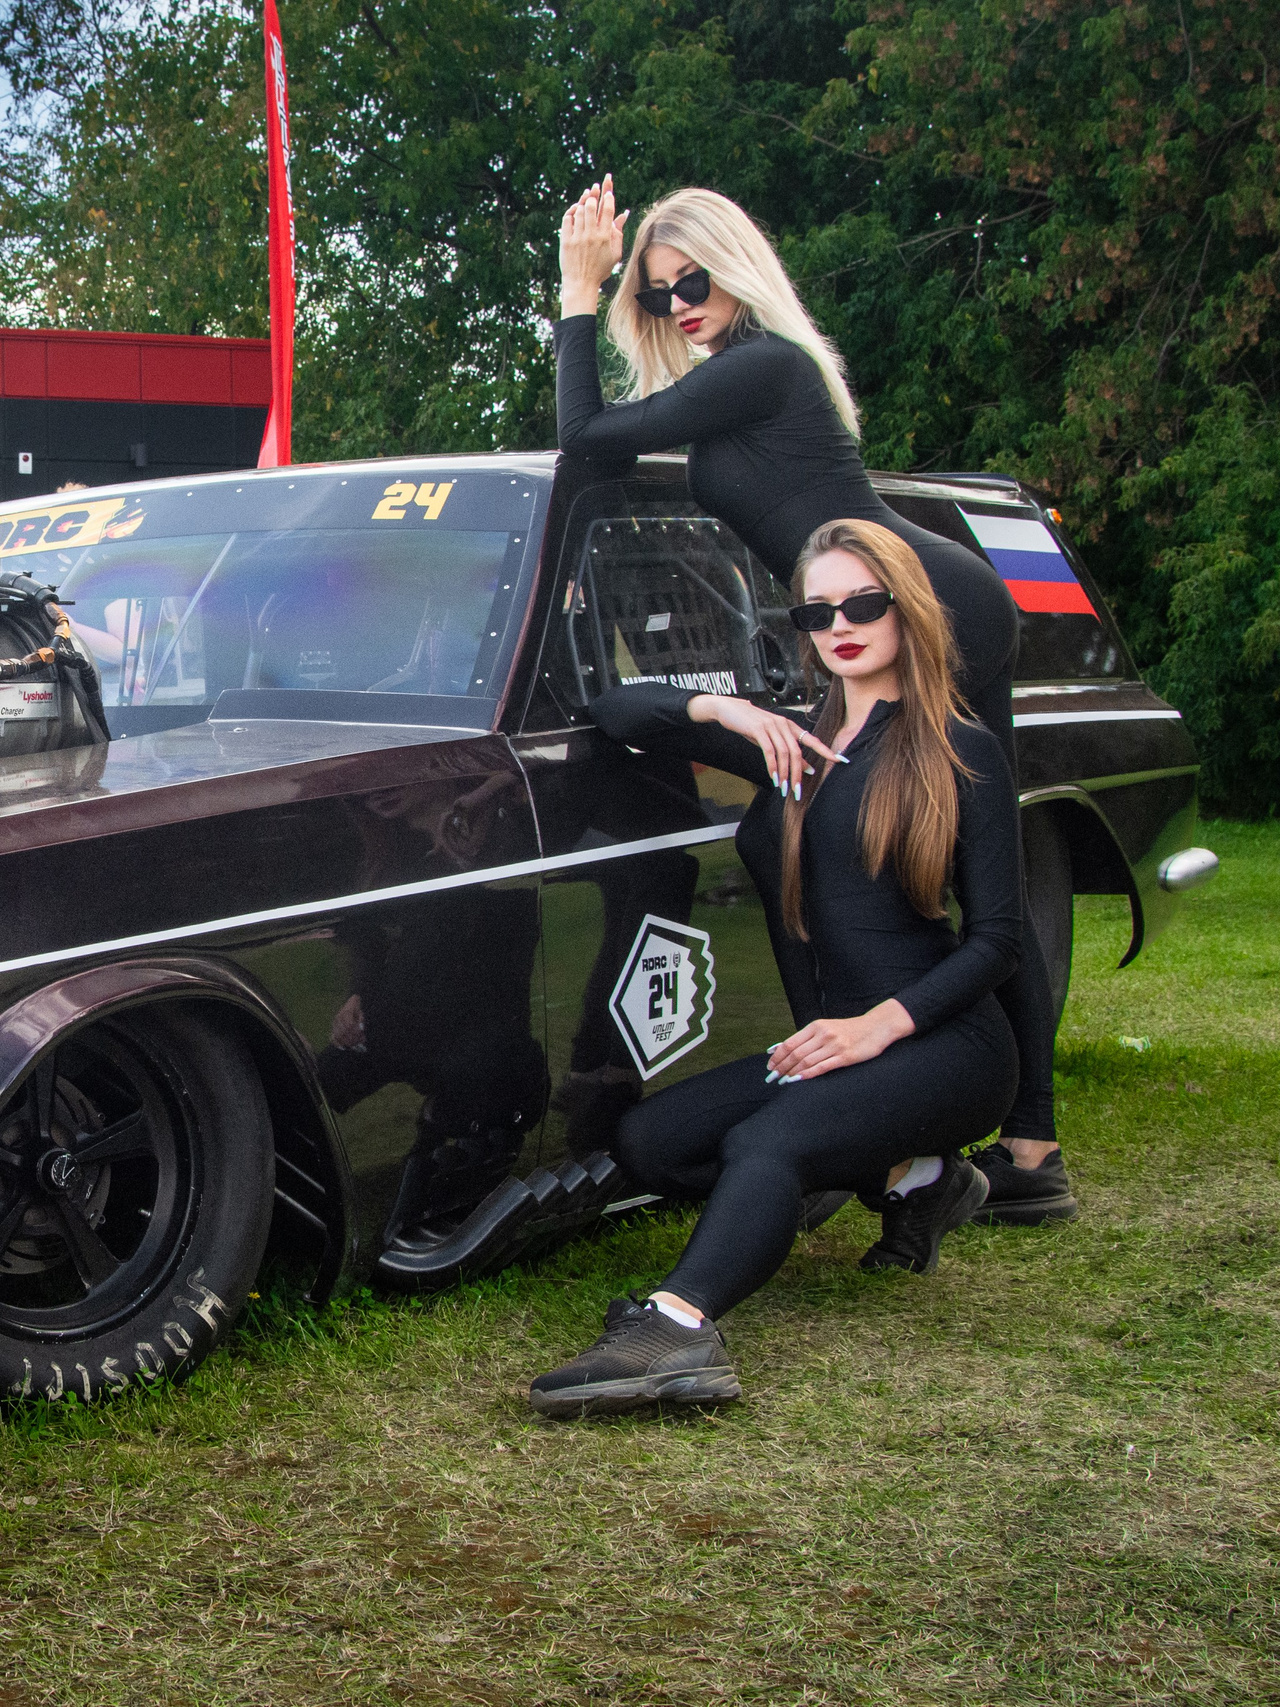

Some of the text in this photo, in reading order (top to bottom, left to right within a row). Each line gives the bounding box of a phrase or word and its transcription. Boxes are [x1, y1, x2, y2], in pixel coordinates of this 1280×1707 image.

[371, 482, 454, 520] 24
[23, 691, 53, 703] Lysholm
[0, 707, 25, 717] Charger
[642, 955, 668, 972] RDRC
[648, 971, 679, 1020] 24
[655, 1031, 673, 1043] FEST
